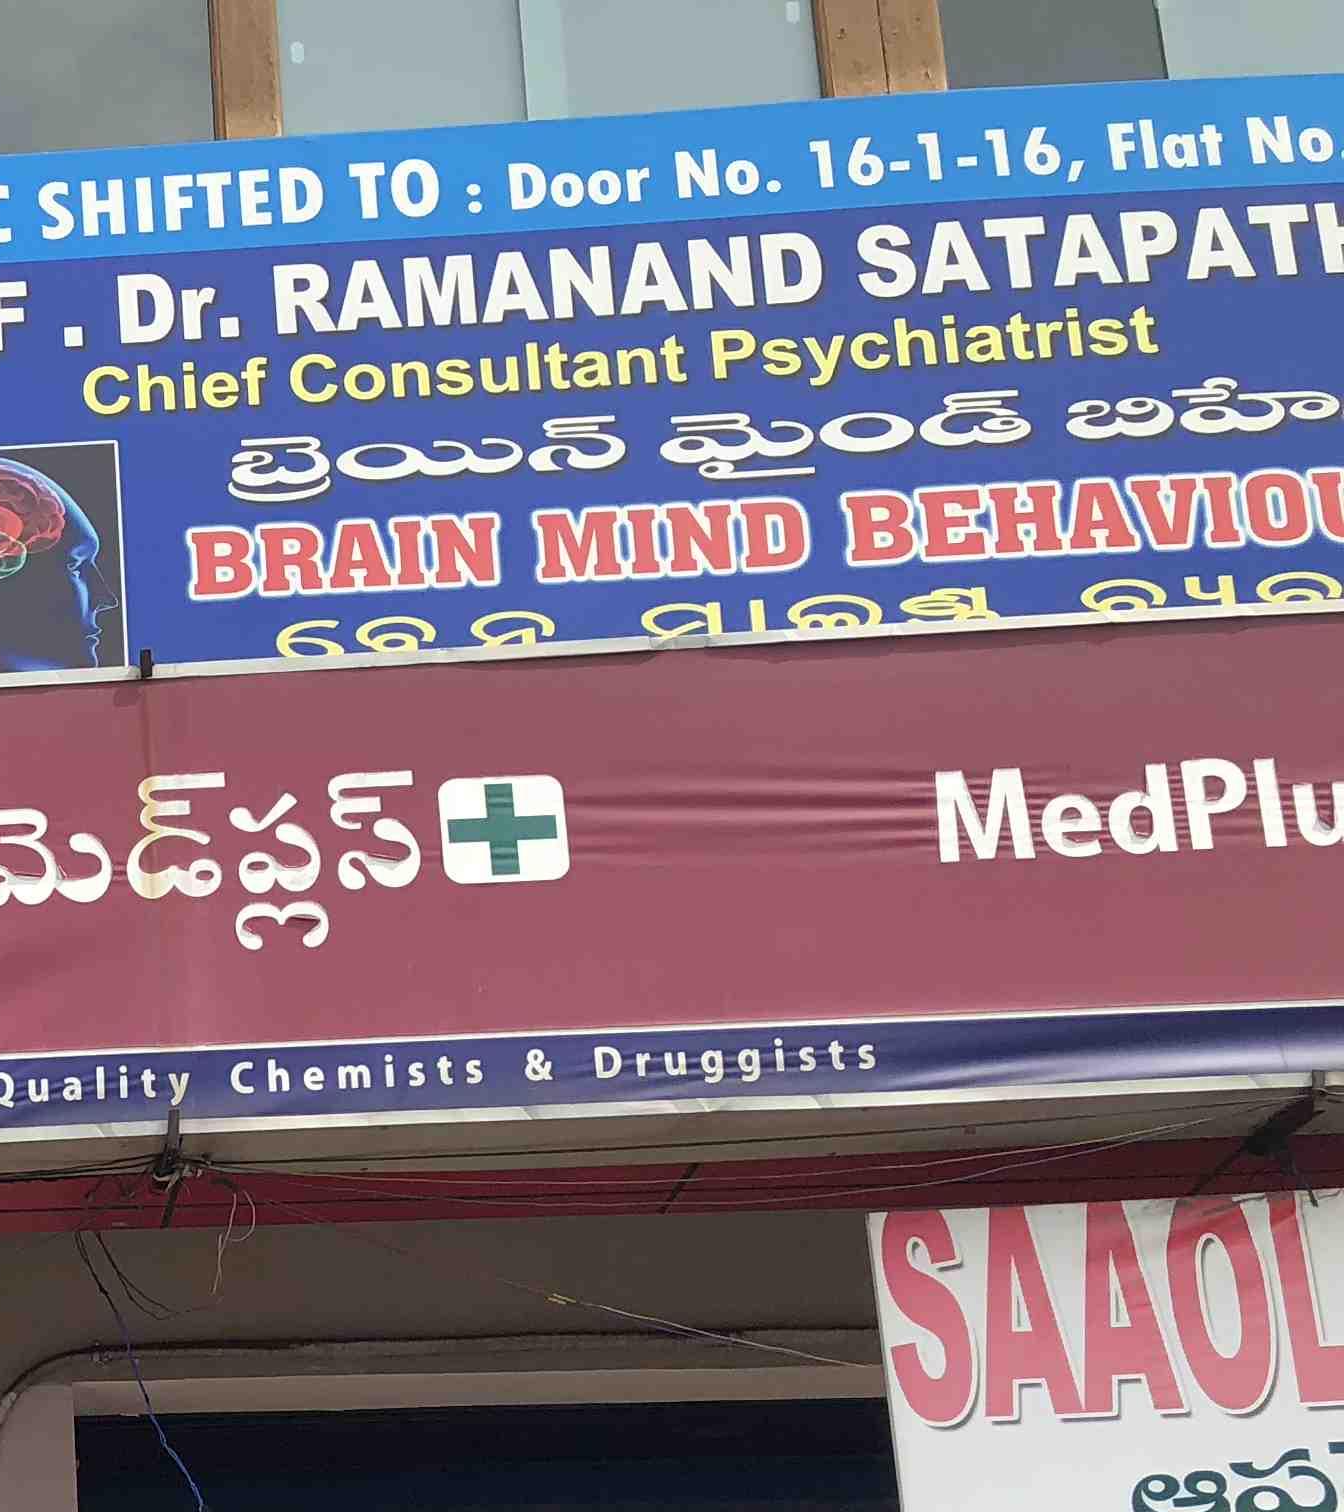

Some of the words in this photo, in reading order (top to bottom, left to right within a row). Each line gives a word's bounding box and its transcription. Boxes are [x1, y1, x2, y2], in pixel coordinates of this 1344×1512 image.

[38, 166, 325, 242] SHIFTED
[347, 157, 441, 220] TO
[507, 161, 651, 212] Door
[674, 149, 781, 200] No.
[808, 125, 1085, 190] 16-1-16,
[1106, 118, 1224, 171] Flat
[117, 271, 242, 345] Dr.
[273, 229, 825, 336] RAMANAND
[82, 355, 269, 417] Chief
[288, 336, 687, 403] Consultant
[711, 304, 1160, 388] Psychiatrist
[187, 513, 501, 602] BRAIN
[535, 496, 810, 585] MIND
[230, 1055, 484, 1095] Chemists
[523, 1049, 553, 1083] &
[594, 1038, 876, 1085] Druggists
